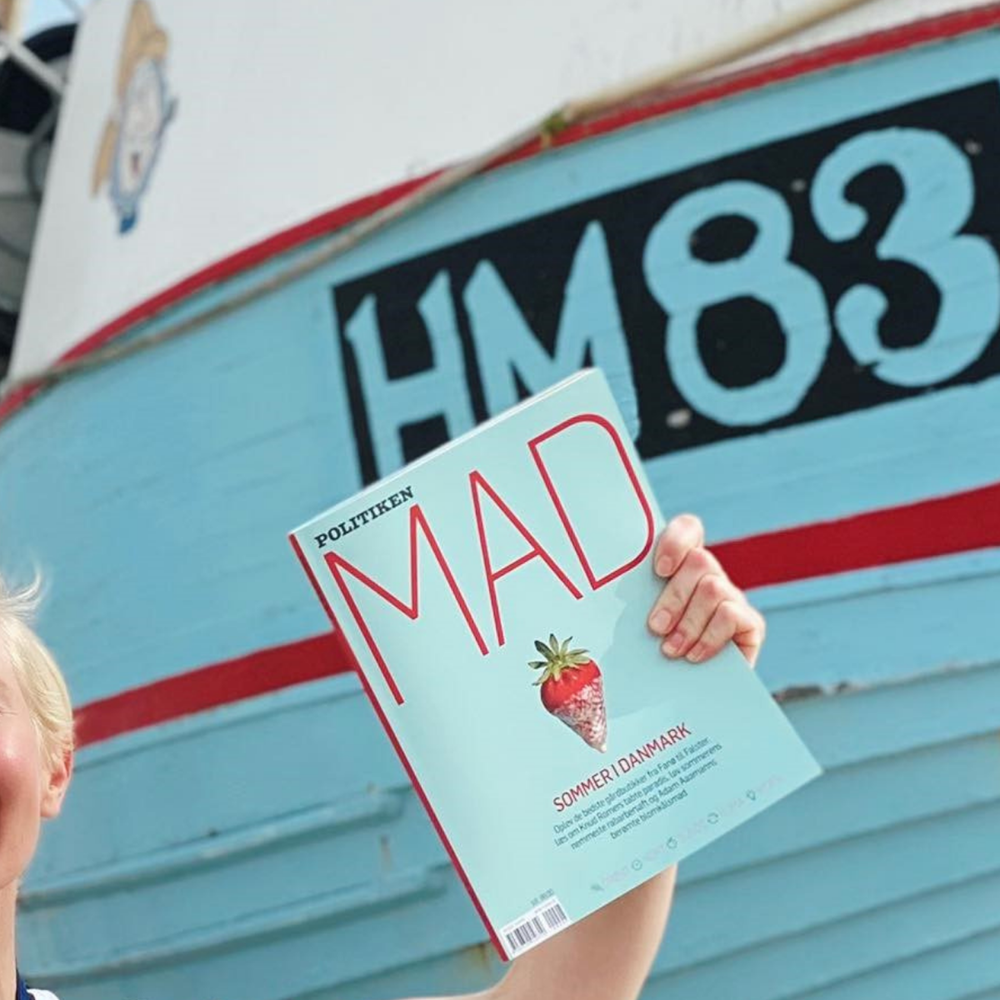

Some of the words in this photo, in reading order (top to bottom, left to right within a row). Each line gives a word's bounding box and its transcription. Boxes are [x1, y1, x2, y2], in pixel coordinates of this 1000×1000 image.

[314, 485, 414, 549] POLITIKEN
[323, 413, 655, 706] MAD
[553, 768, 614, 813] SOMMER
[611, 764, 620, 777] I
[617, 721, 692, 774] DANMARK
[553, 819, 574, 834] Oplev
[573, 813, 583, 822] de
[581, 800, 605, 817] bedste
[646, 768, 659, 778] fra
[675, 752, 686, 761] til
[568, 828, 580, 839] om
[578, 816, 598, 831] Knud
[596, 802, 625, 821] Romers
[681, 744, 722, 771] sommerens
[648, 794, 660, 804] og
[658, 781, 680, 797] Adam
